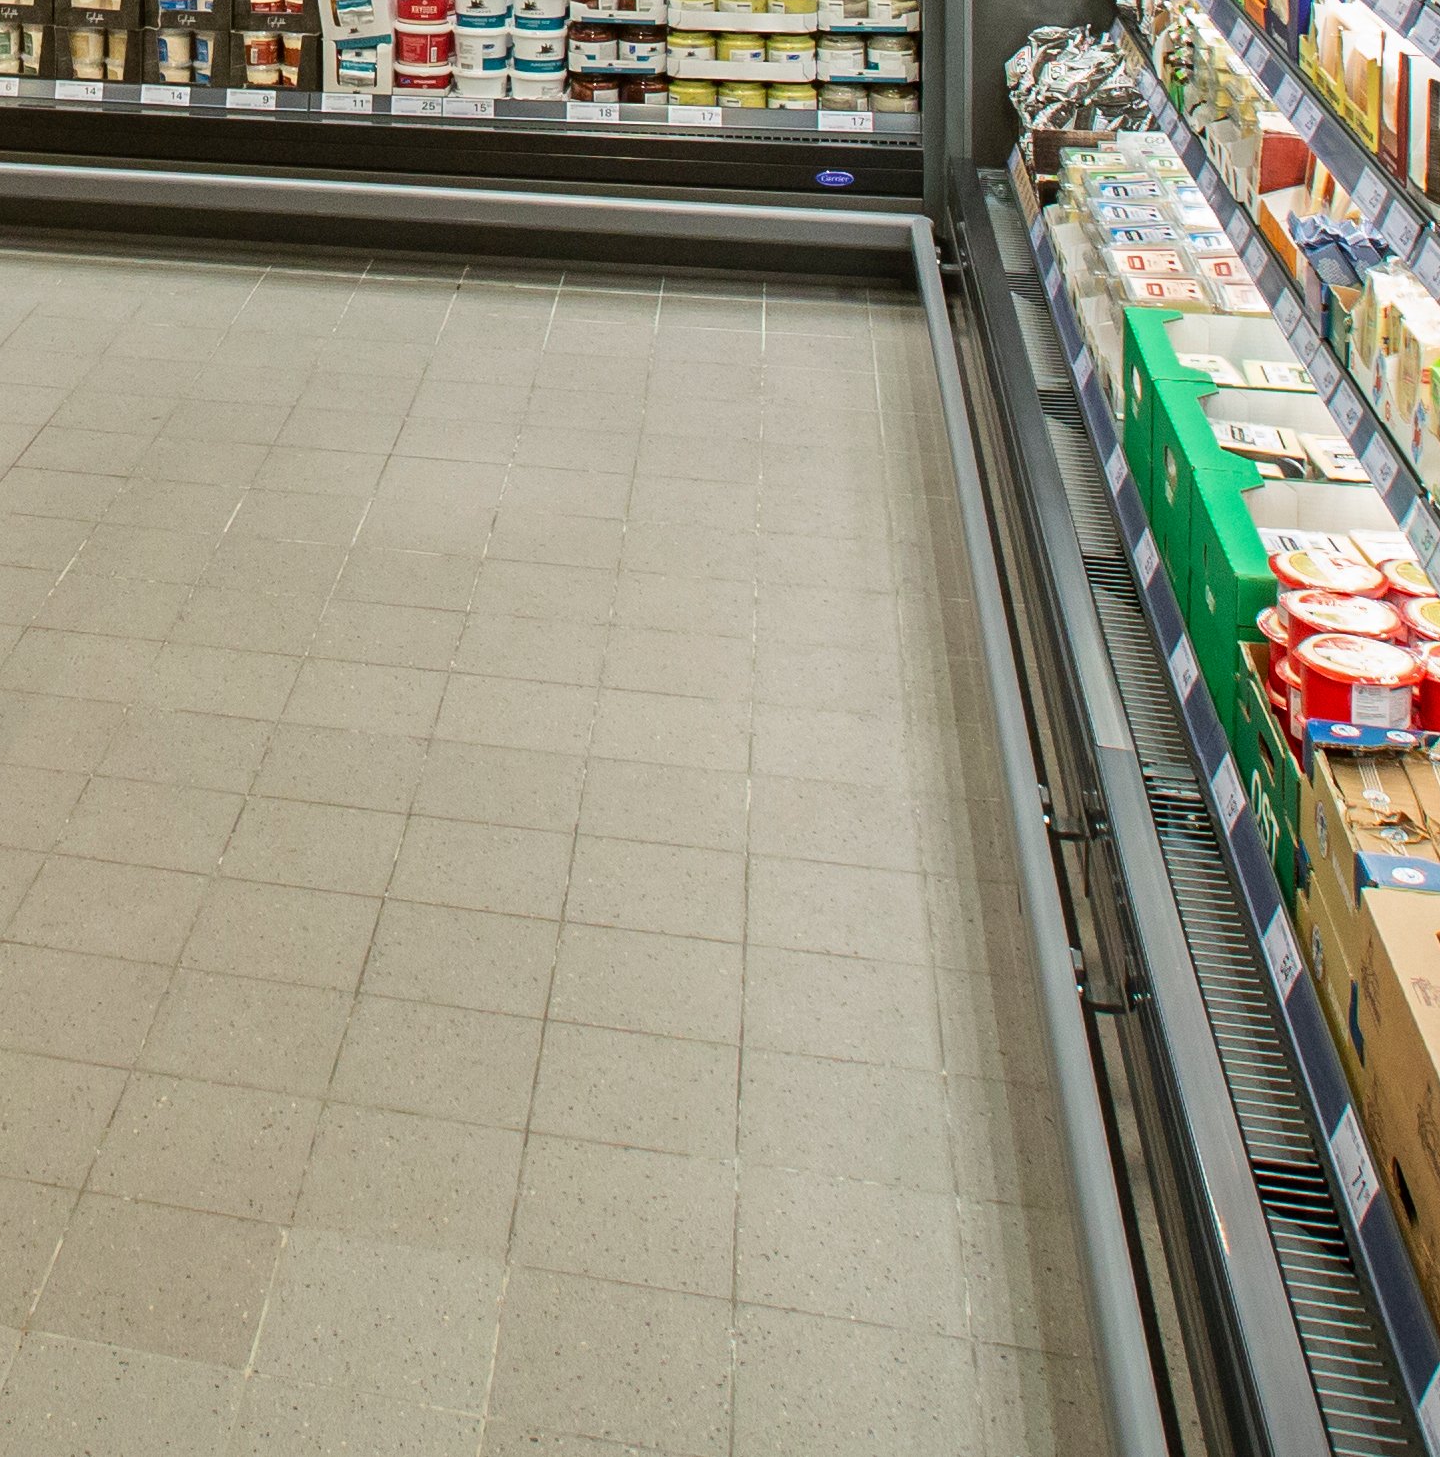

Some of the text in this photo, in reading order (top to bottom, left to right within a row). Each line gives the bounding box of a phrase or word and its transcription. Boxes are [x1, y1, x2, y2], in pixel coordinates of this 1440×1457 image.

[262, 96, 269, 104] 9
[422, 102, 435, 110] 25
[474, 104, 486, 112] 15
[599, 109, 612, 117] 18
[852, 117, 864, 126] 17
